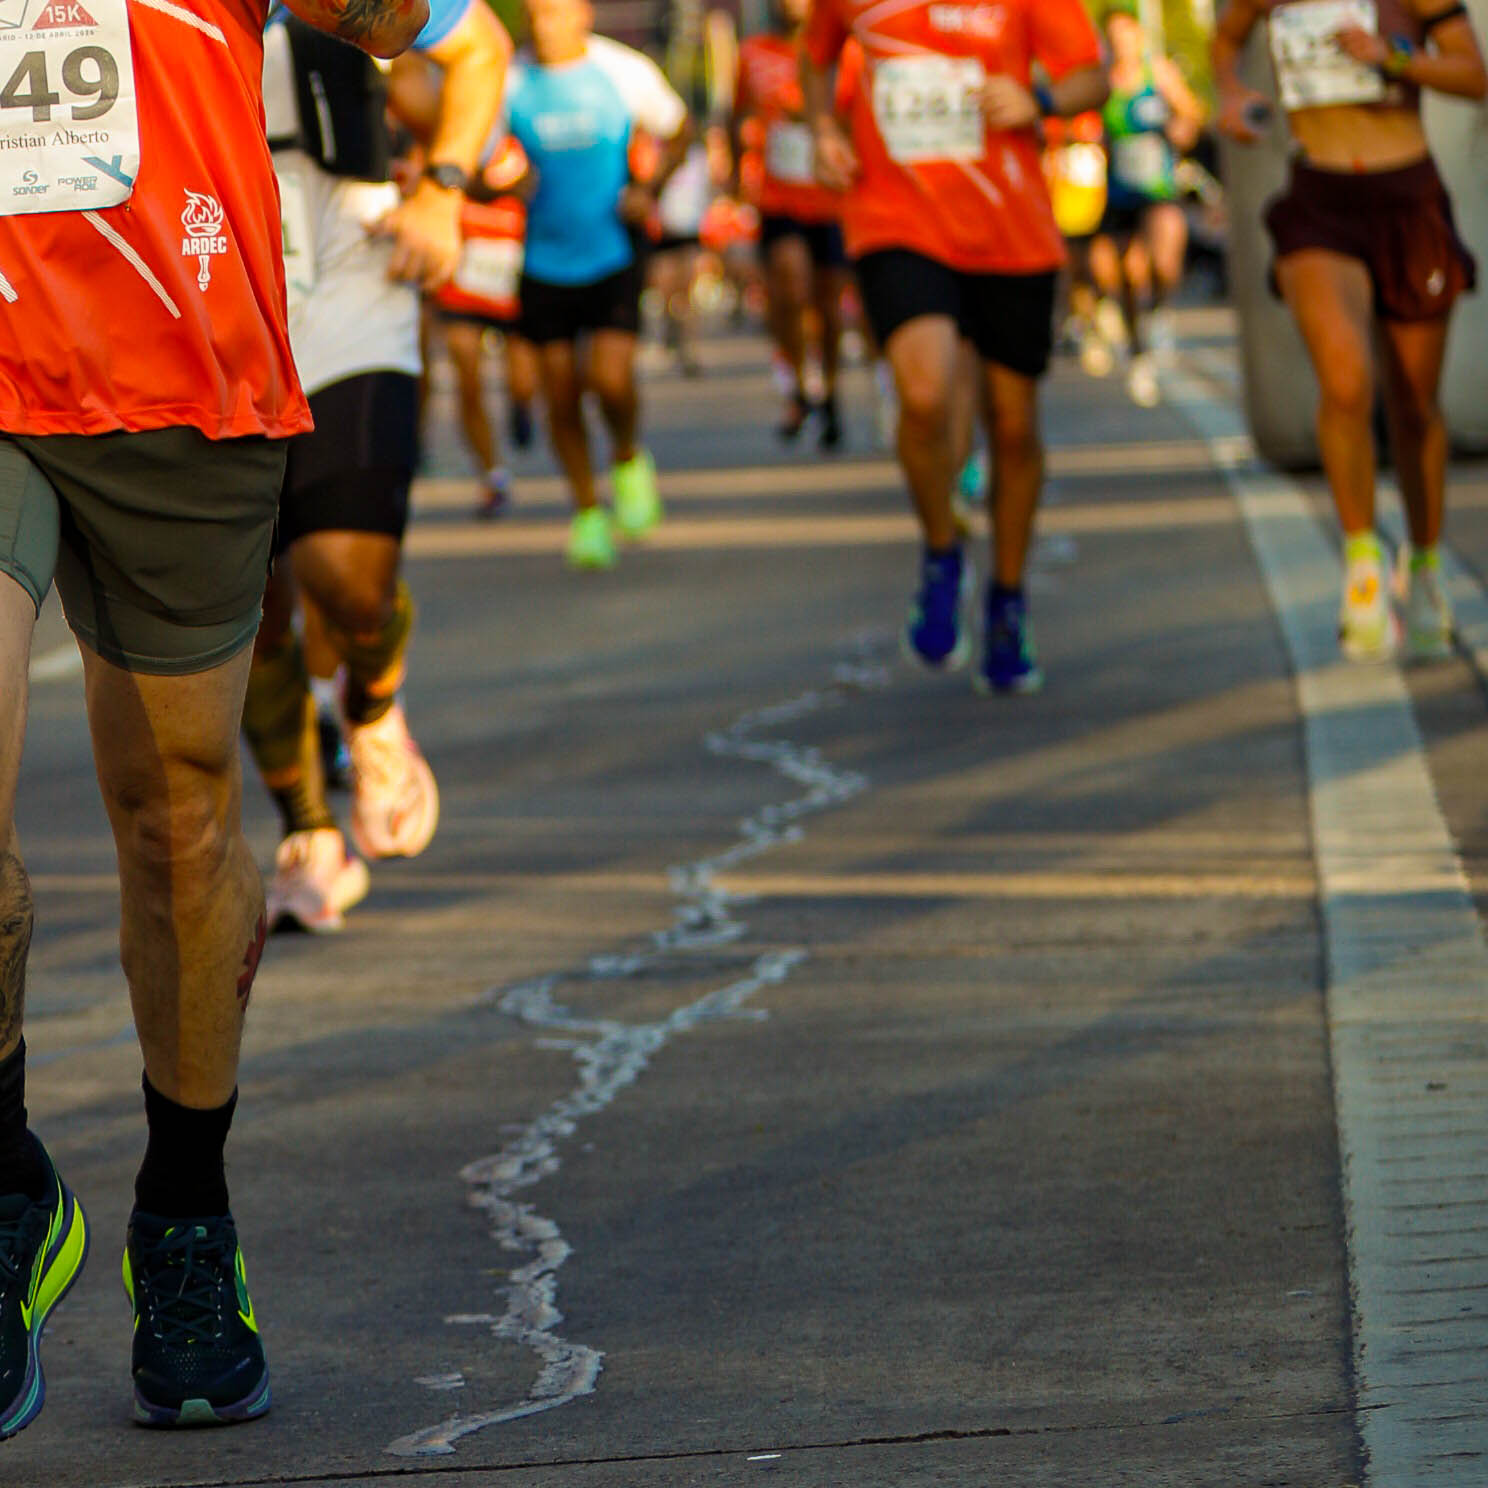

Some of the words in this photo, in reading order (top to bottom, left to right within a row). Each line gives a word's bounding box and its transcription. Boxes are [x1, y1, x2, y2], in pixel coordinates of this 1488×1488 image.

[46, 4, 82, 24] 15K
[52, 129, 110, 147] Alberto
[181, 236, 227, 256] ARDEC
